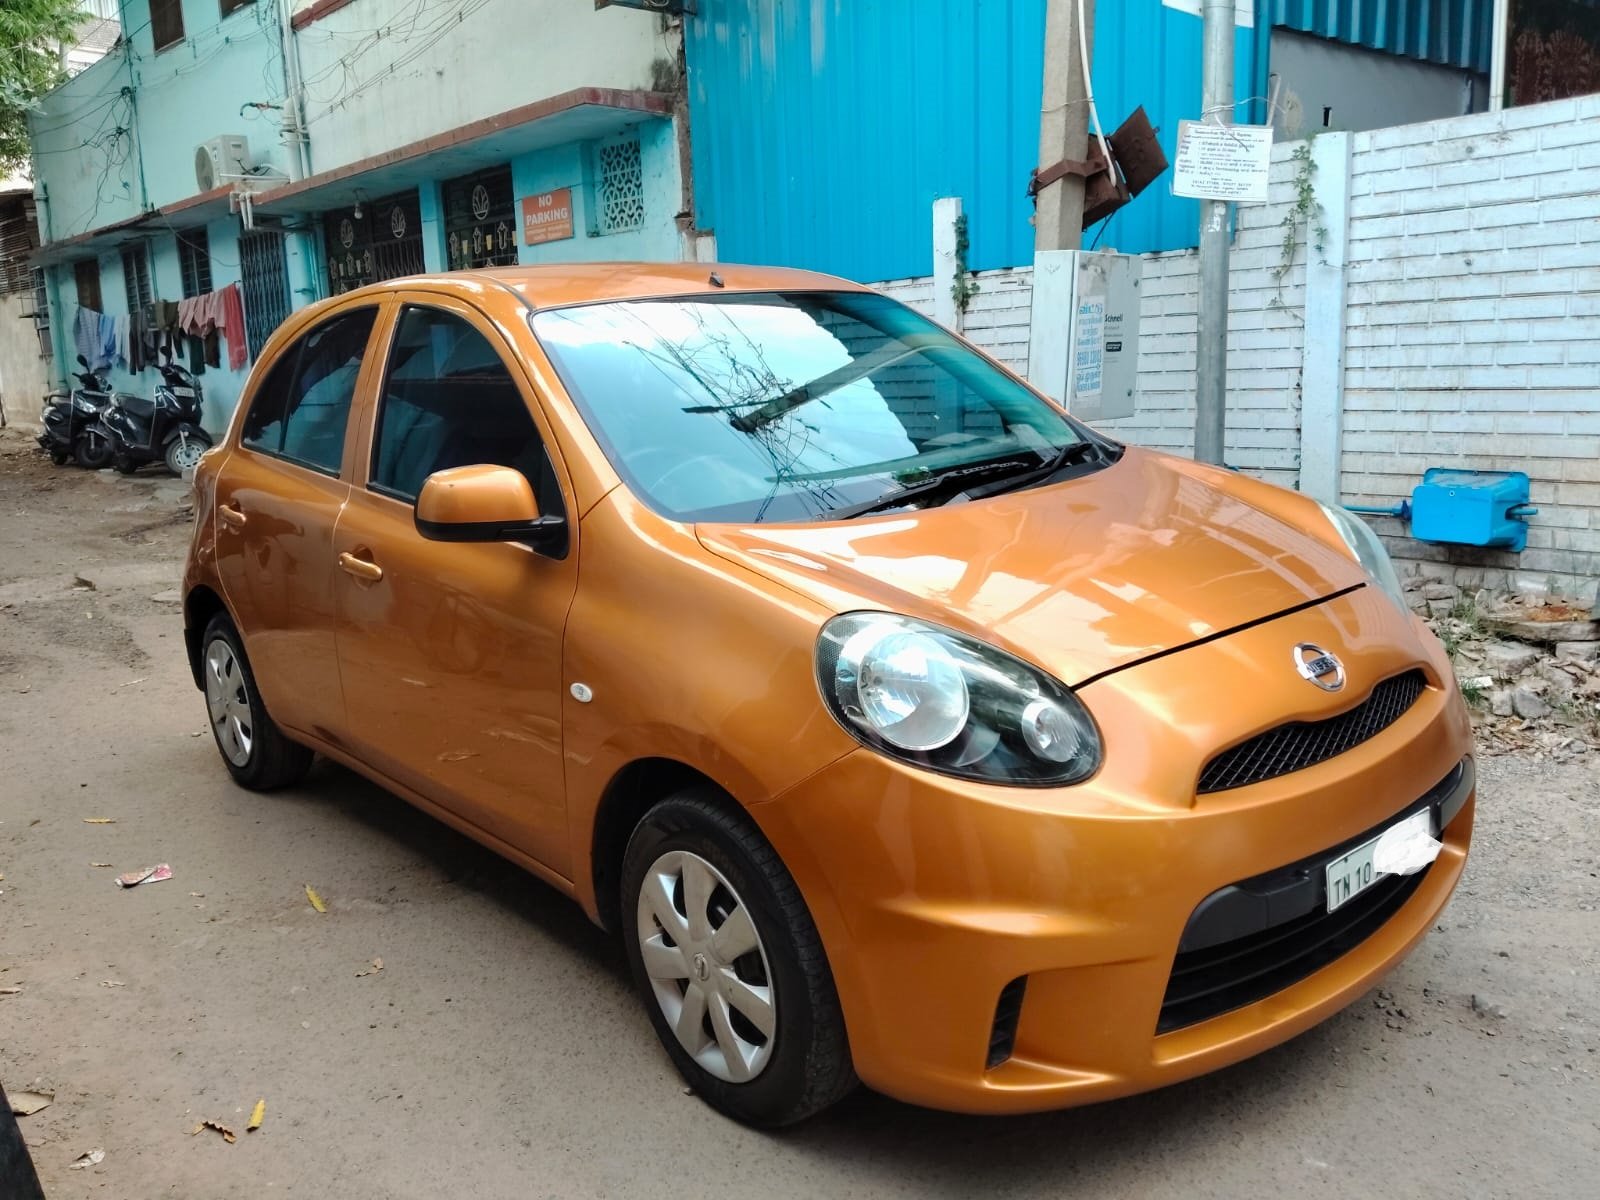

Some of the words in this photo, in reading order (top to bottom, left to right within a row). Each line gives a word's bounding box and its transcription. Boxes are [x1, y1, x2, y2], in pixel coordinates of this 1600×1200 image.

[538, 194, 553, 208] NO
[526, 207, 569, 226] PARKING
[1104, 312, 1124, 323] Schnell
[1333, 873, 1351, 905] TN
[1355, 861, 1372, 893] 10
